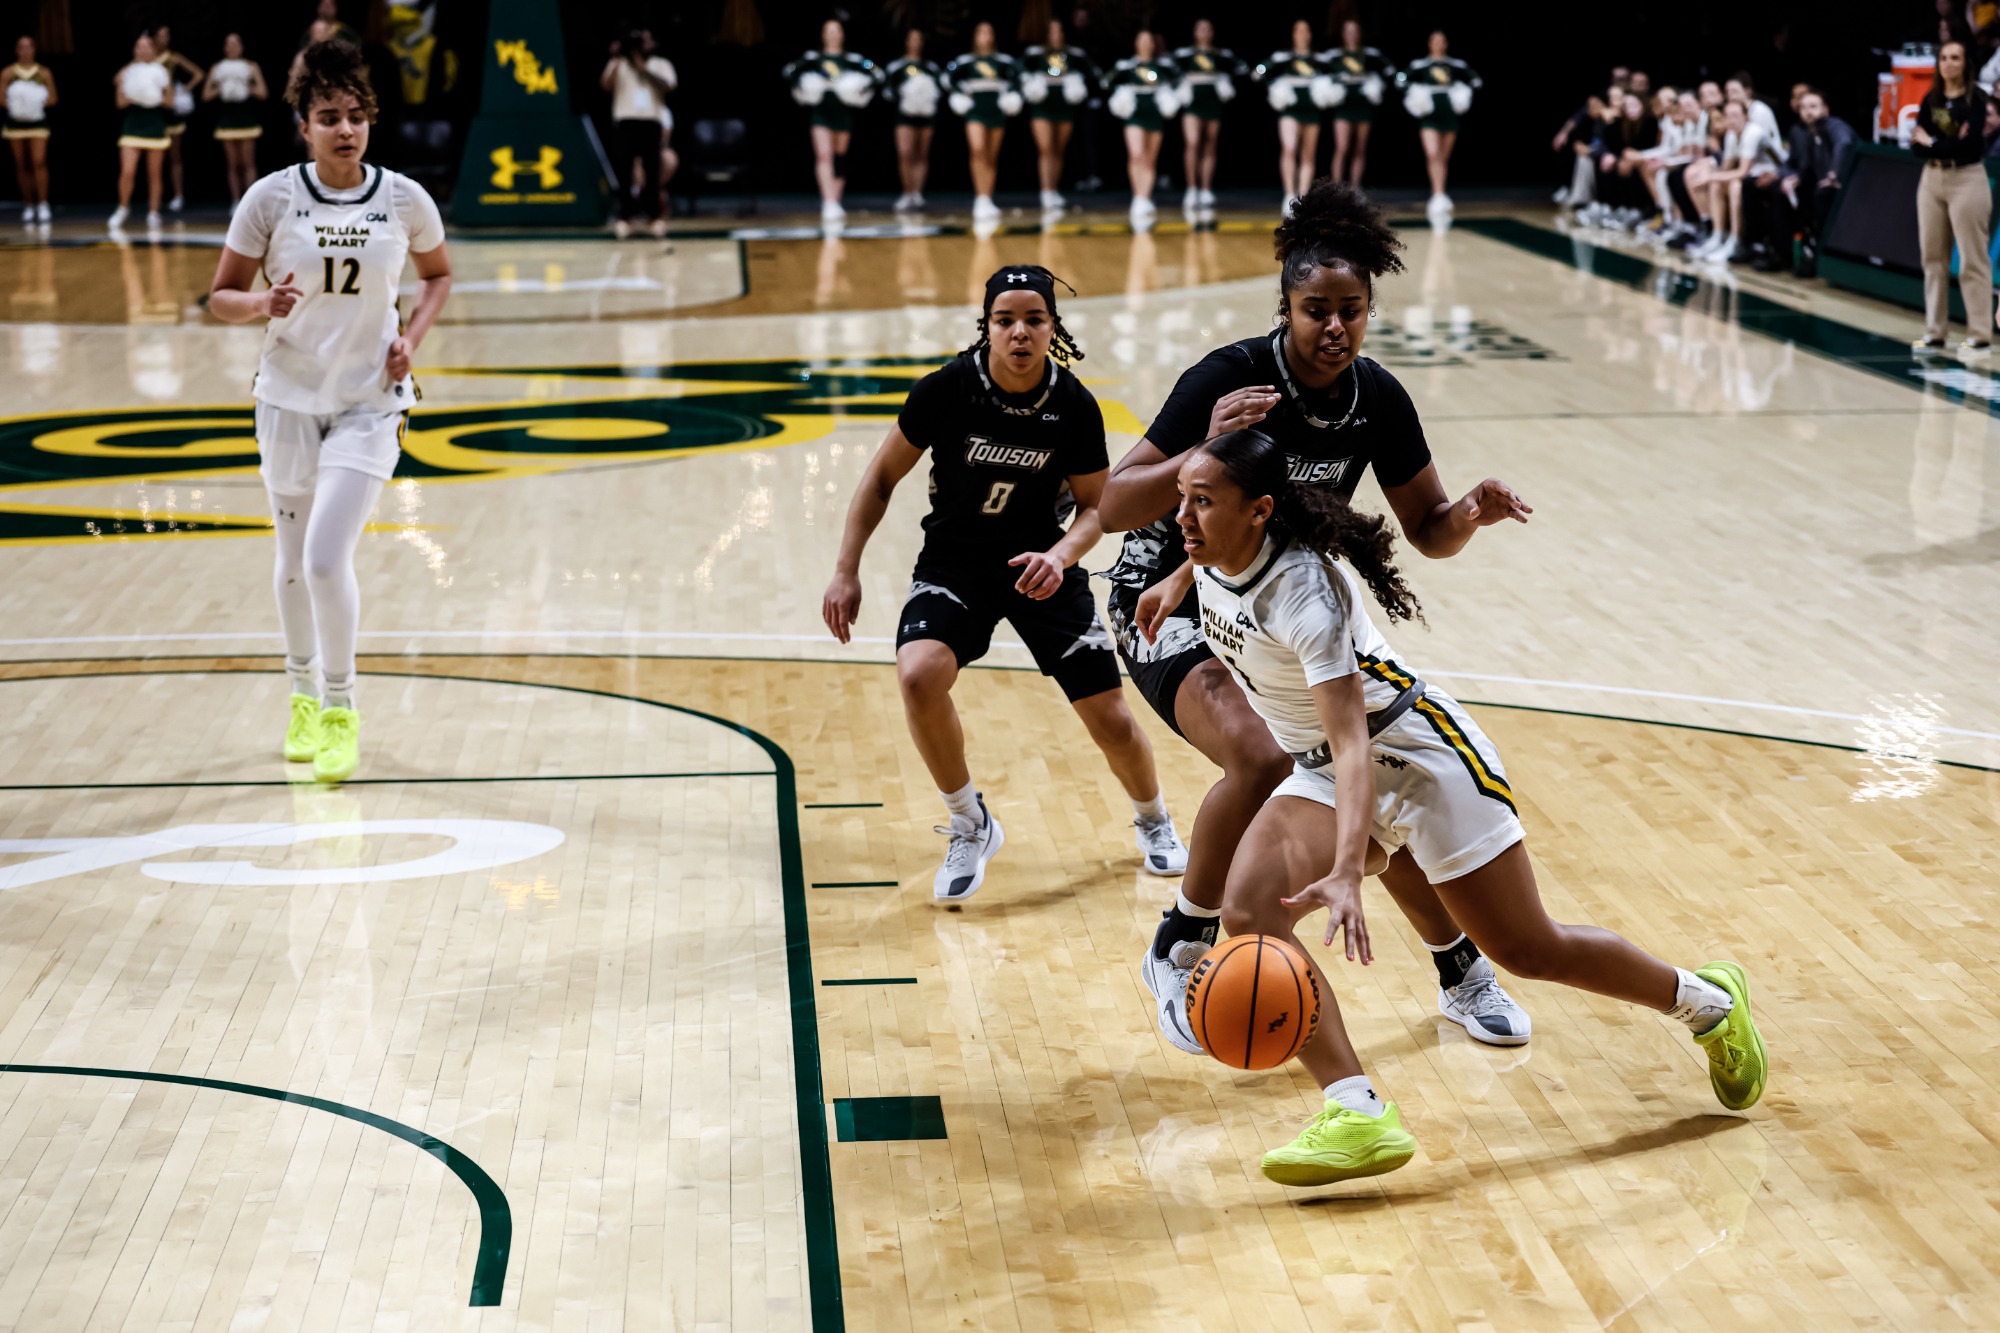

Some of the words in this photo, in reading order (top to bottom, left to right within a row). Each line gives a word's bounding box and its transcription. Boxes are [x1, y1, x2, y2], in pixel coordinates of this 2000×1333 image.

[314, 225, 370, 236] WILLIAM
[366, 212, 388, 223] CAA
[322, 256, 361, 295] 12
[966, 435, 1053, 472] TOWSON
[981, 481, 1016, 515] 0
[1202, 603, 1245, 642] WILLIAM
